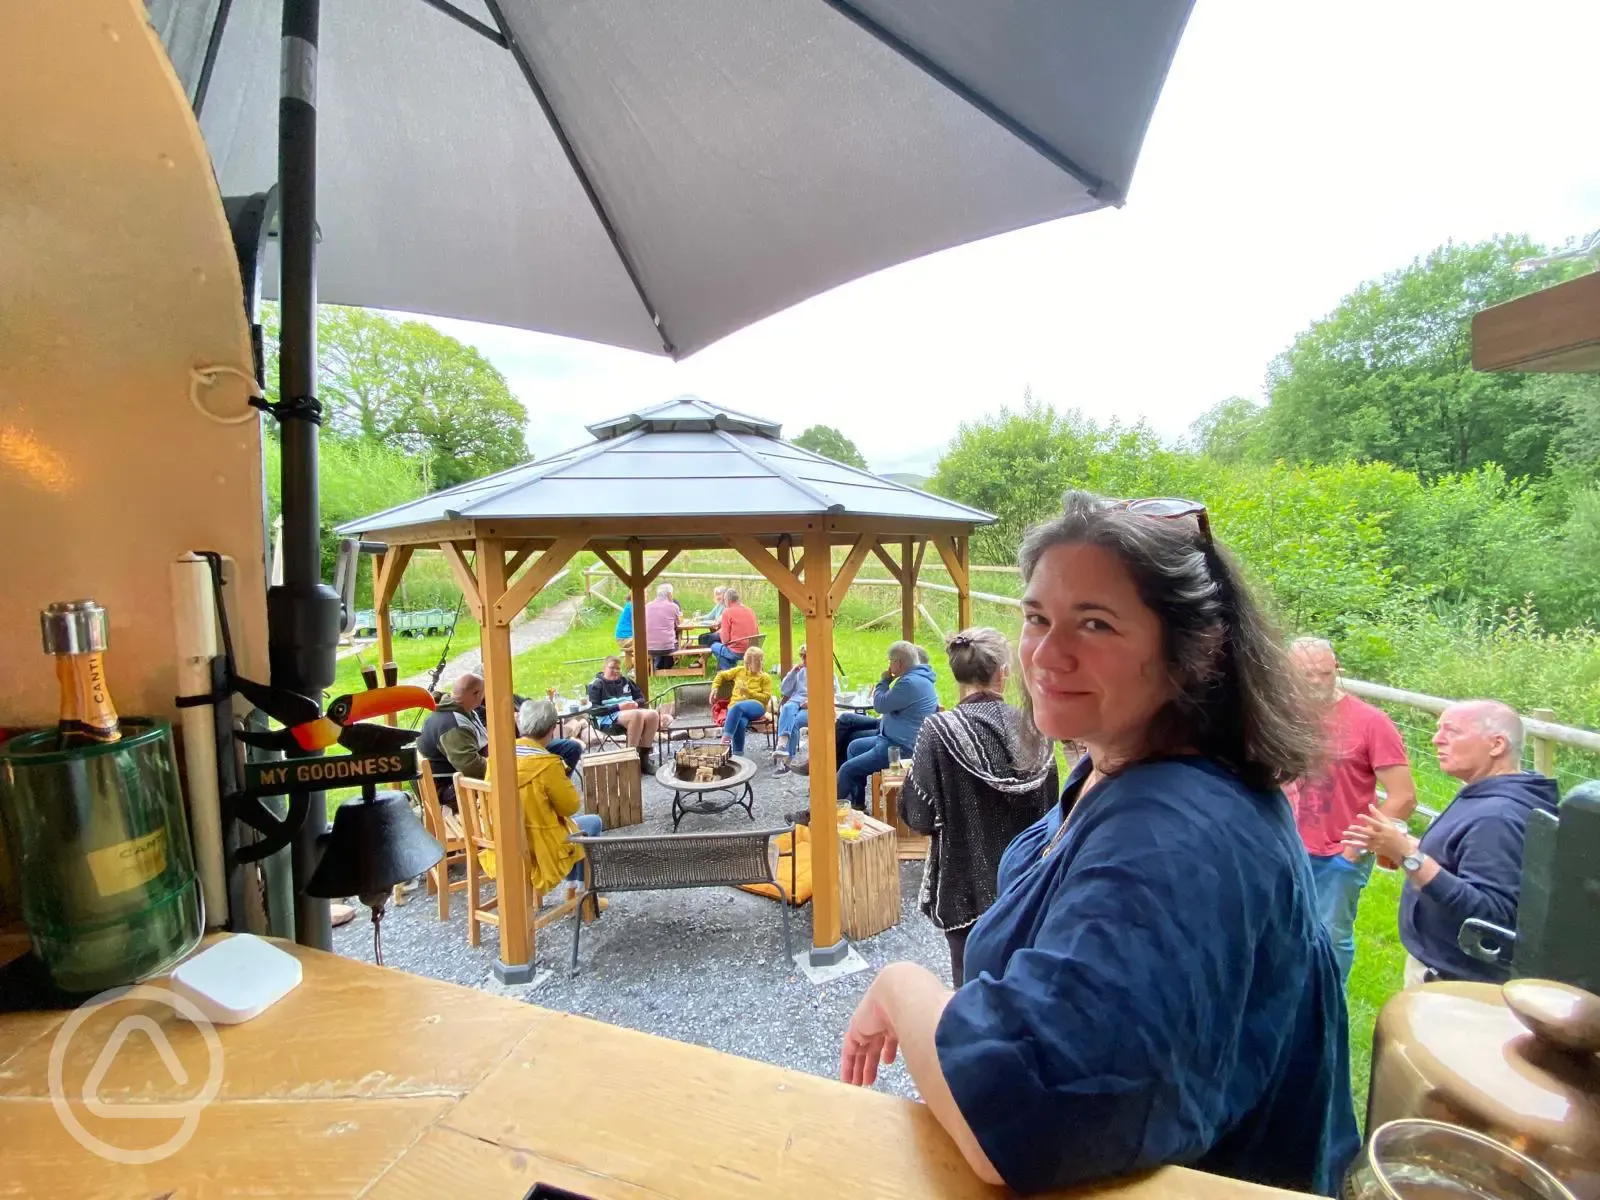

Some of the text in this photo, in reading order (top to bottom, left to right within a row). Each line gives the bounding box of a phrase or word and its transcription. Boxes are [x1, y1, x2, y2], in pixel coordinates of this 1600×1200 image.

[88, 658, 104, 704] CANTI
[260, 755, 403, 786] MY GOODNESS
